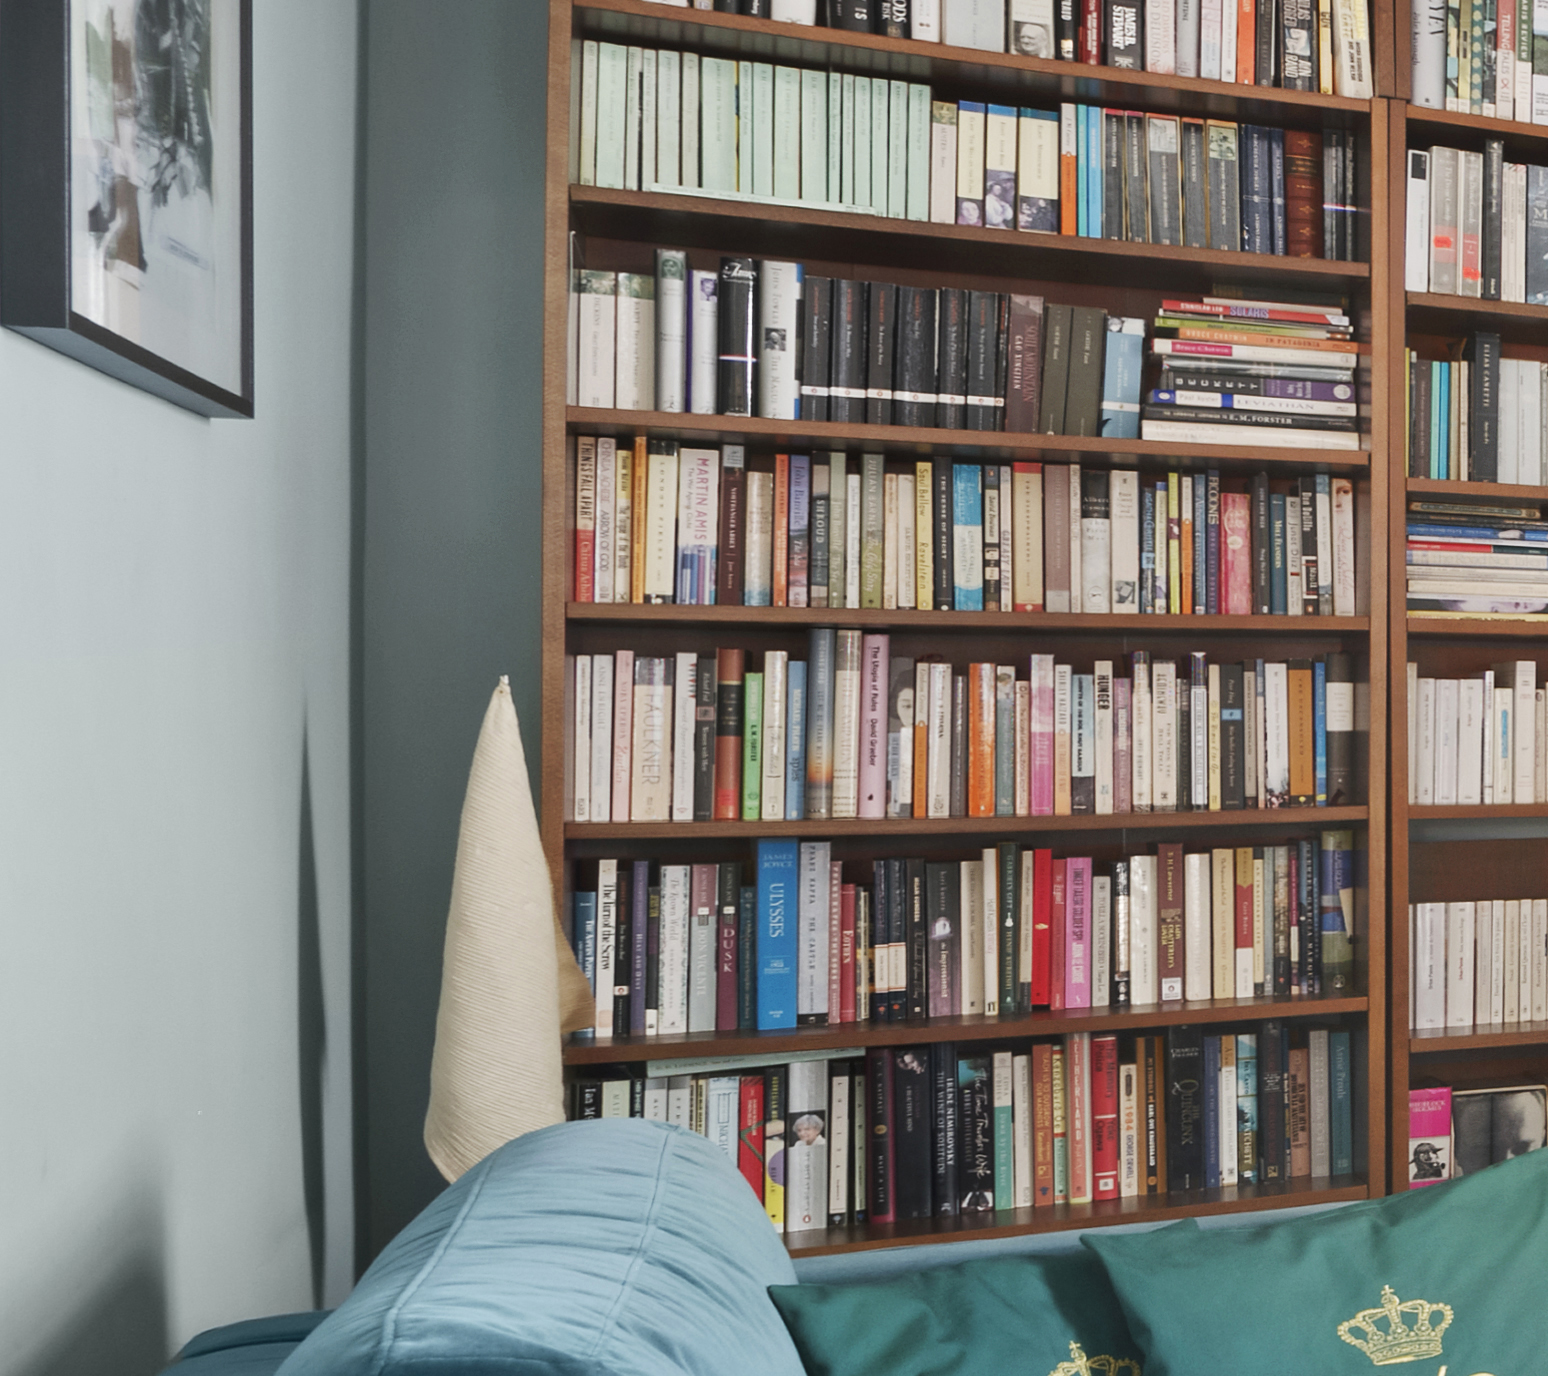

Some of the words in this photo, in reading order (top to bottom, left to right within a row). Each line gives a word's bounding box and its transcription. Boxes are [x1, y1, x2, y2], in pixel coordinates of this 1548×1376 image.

[854, 7, 867, 20] IS
[882, 3, 891, 20] RISK
[1124, 8, 1136, 35] JAMES
[1112, 5, 1125, 50] STEWART
[1150, 14, 1160, 65] DELUSION
[1501, 14, 1511, 49] TELLING
[1520, 23, 1528, 59] REVIEW
[1285, 55, 1298, 79] RAND
[1299, 60, 1311, 77] AYN
[1501, 51, 1510, 74] TALES
[771, 290, 781, 325] FOWLES
[1230, 305, 1269, 320] SOLARIS
[1014, 335, 1023, 351] GAO
[1278, 338, 1321, 348] PATAGONIA
[1483, 344, 1491, 368] ELIAS
[1024, 348, 1037, 402] MOUNTAIN
[1176, 377, 1259, 391] BECKETT
[1482, 370, 1491, 407] CANETTI
[1237, 397, 1315, 410] LEVIATHAN
[580, 442, 594, 472] THINGS
[580, 473, 594, 492] FALL
[695, 458, 709, 506] MARTIN
[867, 459, 877, 492] JULIAN
[579, 495, 593, 521] APART
[917, 489, 927, 517] Bellow
[1208, 476, 1220, 525] FICCIONES
[1303, 492, 1312, 505] Don
[600, 510, 611, 539] ARROW
[695, 511, 707, 541] AMIS
[815, 499, 825, 543] SHROUD
[600, 553, 610, 572] GOD
[917, 542, 927, 590] Ravelstein
[872, 646, 880, 658] The
[871, 661, 880, 682] Utopia
[871, 693, 880, 711] Rules
[1097, 674, 1110, 710] HUNGER
[642, 694, 660, 785] FAULKNER
[870, 718, 879, 737] David
[870, 739, 878, 766] Graeber
[602, 884, 613, 899] The
[769, 883, 784, 938] ULYSSES
[601, 929, 611, 942] the
[697, 929, 707, 951] DON
[600, 945, 610, 971] Screw
[724, 929, 735, 972] DUSK
[697, 954, 707, 995] VICENTE
[940, 950, 949, 997] Impressionist
[1095, 1044, 1104, 1072] Police
[1073, 1032, 1081, 1141] NETHERLAND
[1106, 1062, 1117, 1098] Memory
[937, 1092, 945, 1114] WINE
[937, 1118, 945, 1129] OF
[1125, 1105, 1134, 1131] 1984
[945, 1108, 954, 1165] NEMIROVSKY
[1095, 1120, 1105, 1151] Ogawa
[1126, 1134, 1134, 1156] GEORGE
[1244, 1124, 1252, 1164] PATCHETT
[936, 1132, 945, 1174] SOLITUDE
[1125, 1158, 1133, 1179] ORWELL
